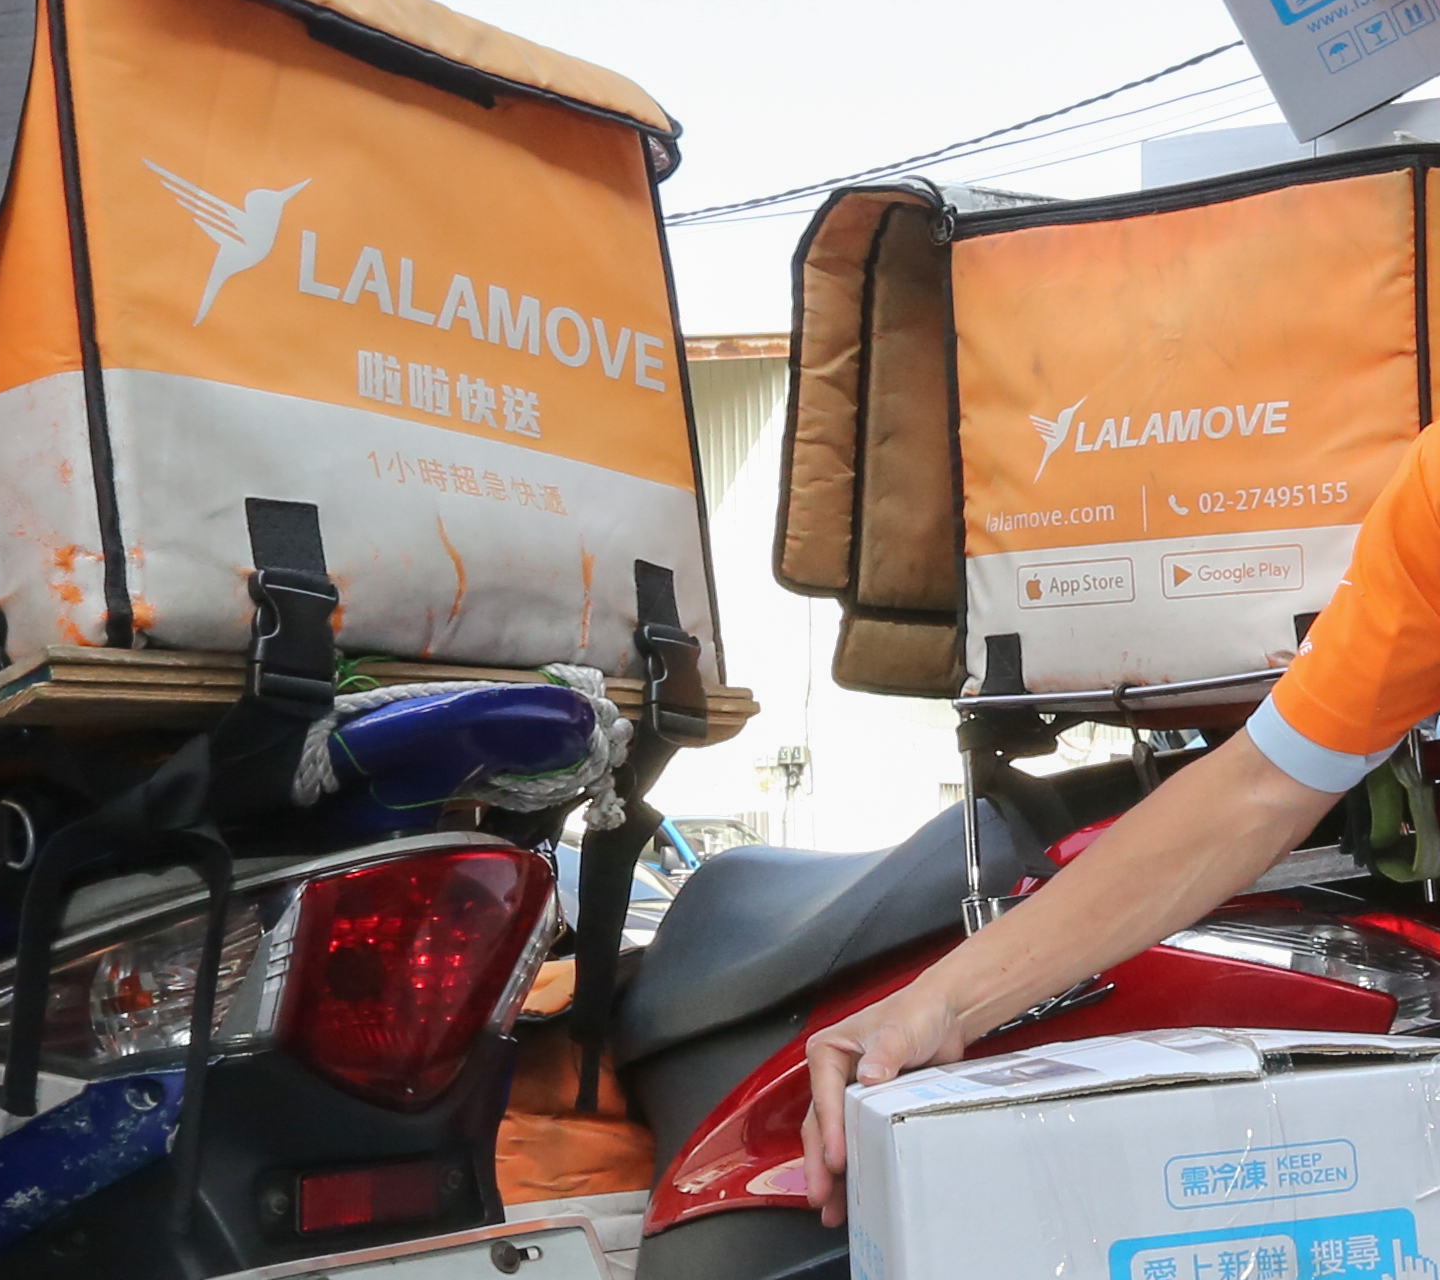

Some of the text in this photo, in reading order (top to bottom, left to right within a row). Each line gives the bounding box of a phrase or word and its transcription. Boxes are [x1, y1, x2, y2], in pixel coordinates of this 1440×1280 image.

[298, 229, 665, 392] LALAMOVE
[357, 349, 542, 439] 啦啦快送
[1074, 401, 1290, 453] LALAMOVE
[366, 450, 568, 516] 1小時超急快遞
[985, 481, 1349, 533] lalamove.com 02-27495155
[1049, 572, 1124, 596] App Store
[1197, 561, 1291, 584] Google Play
[1181, 1160, 1269, 1197] 需冷凍
[1276, 1153, 1323, 1171] KEEP
[1278, 1167, 1348, 1188] FROZEN
[1310, 1234, 1382, 1278] 搜尋
